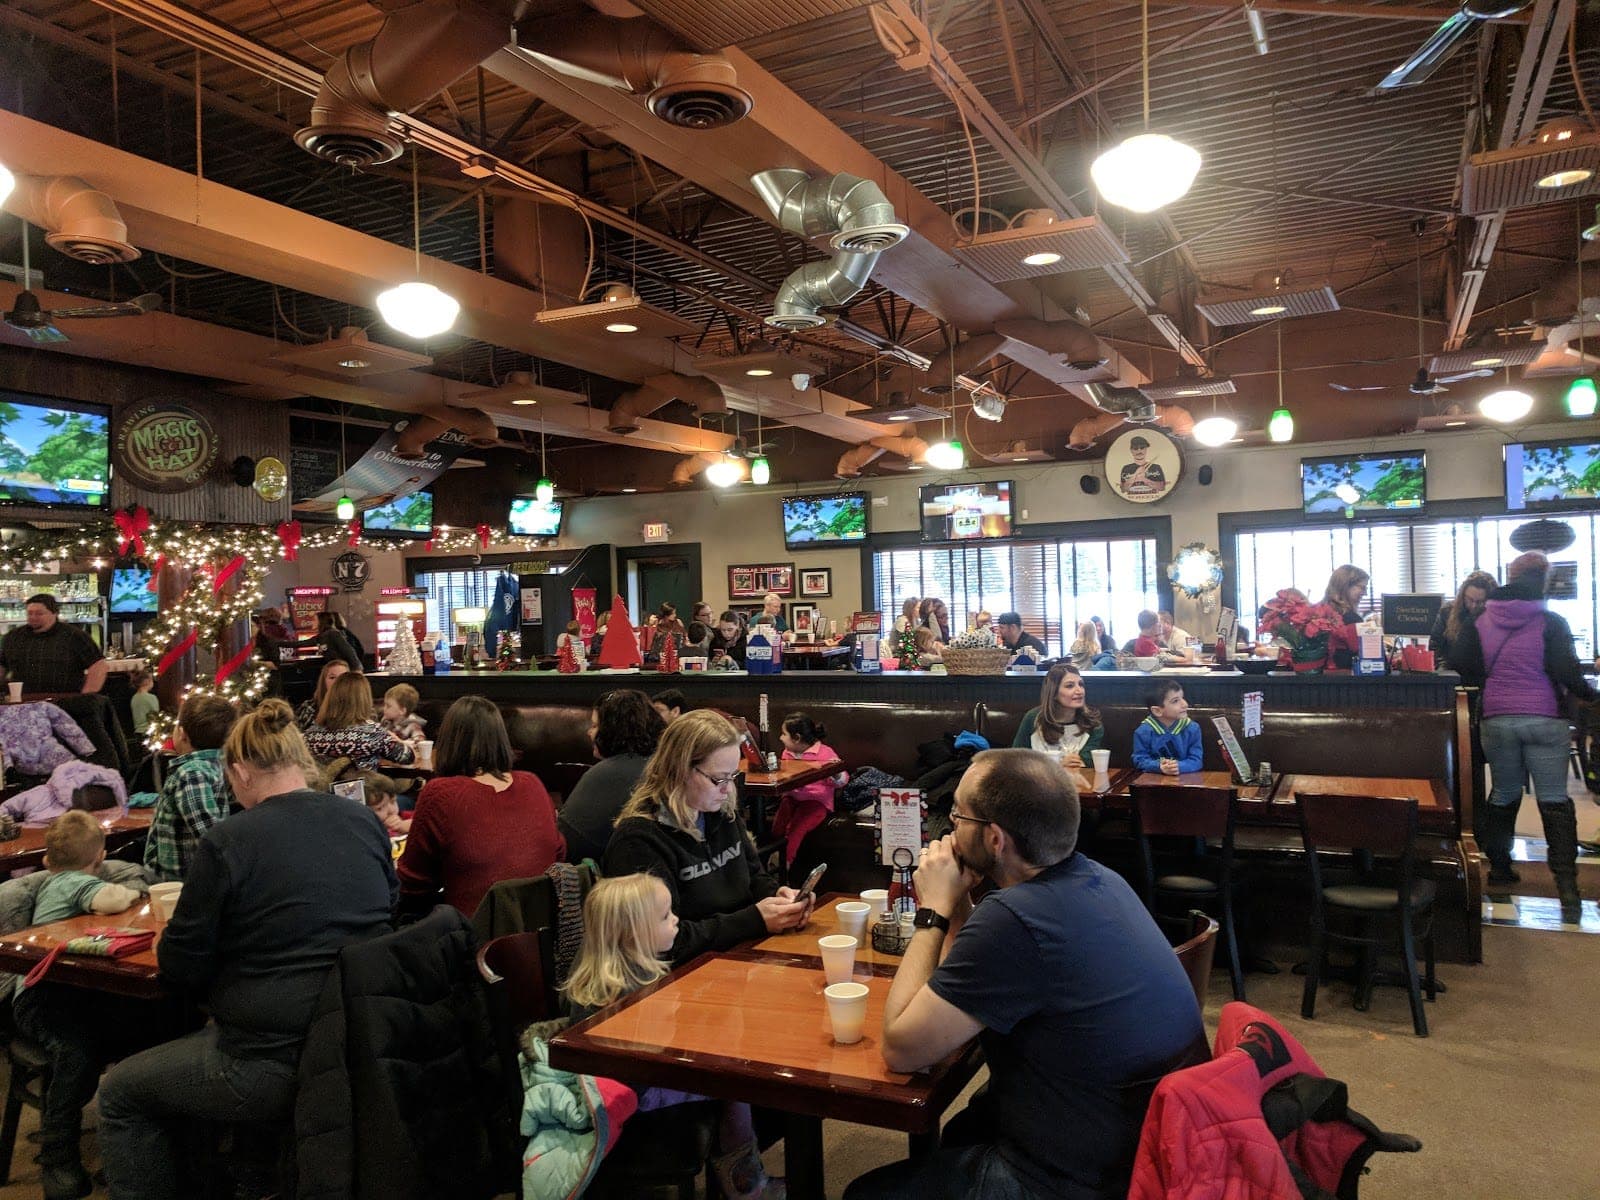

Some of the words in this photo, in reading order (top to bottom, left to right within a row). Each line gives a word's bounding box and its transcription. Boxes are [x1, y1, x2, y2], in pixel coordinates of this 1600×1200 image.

[134, 420, 200, 452] MAGIC
[146, 447, 196, 470] HAT
[647, 524, 662, 538] EXIT
[680, 861, 712, 881] OLD
[711, 840, 742, 871] NAV
